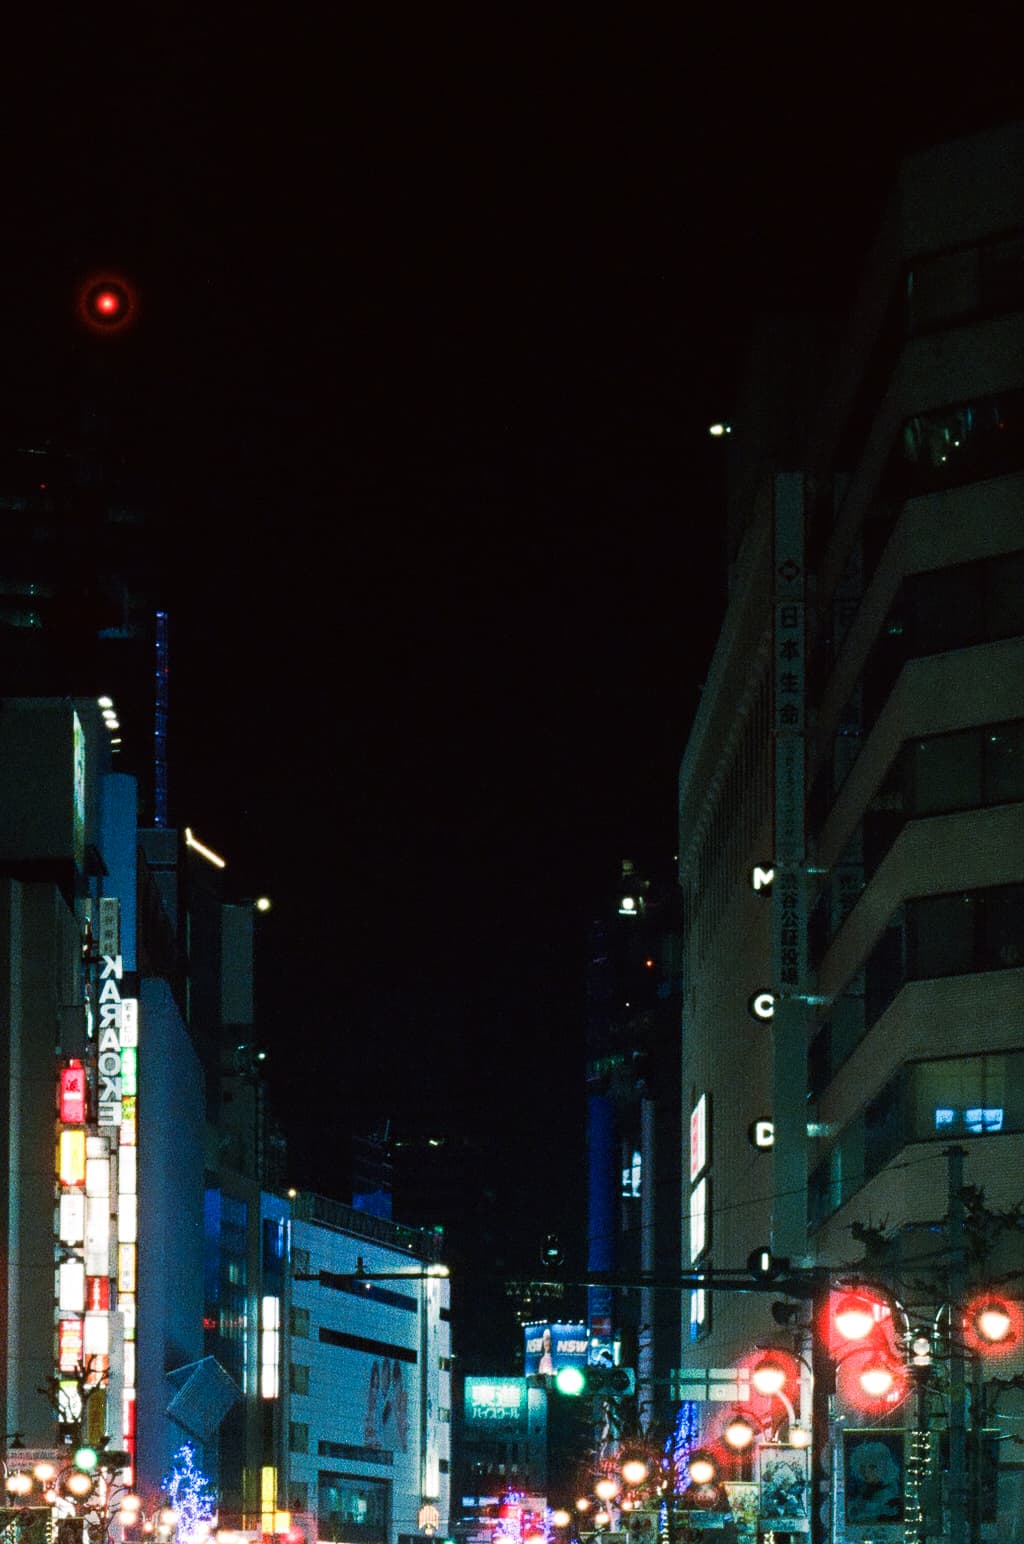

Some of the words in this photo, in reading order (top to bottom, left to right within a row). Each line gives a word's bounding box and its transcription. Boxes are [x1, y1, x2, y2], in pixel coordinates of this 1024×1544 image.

[779, 606, 800, 725] 日本生命
[557, 1340, 588, 1352] NSW
[472, 1407, 520, 1419] ハイスクール
